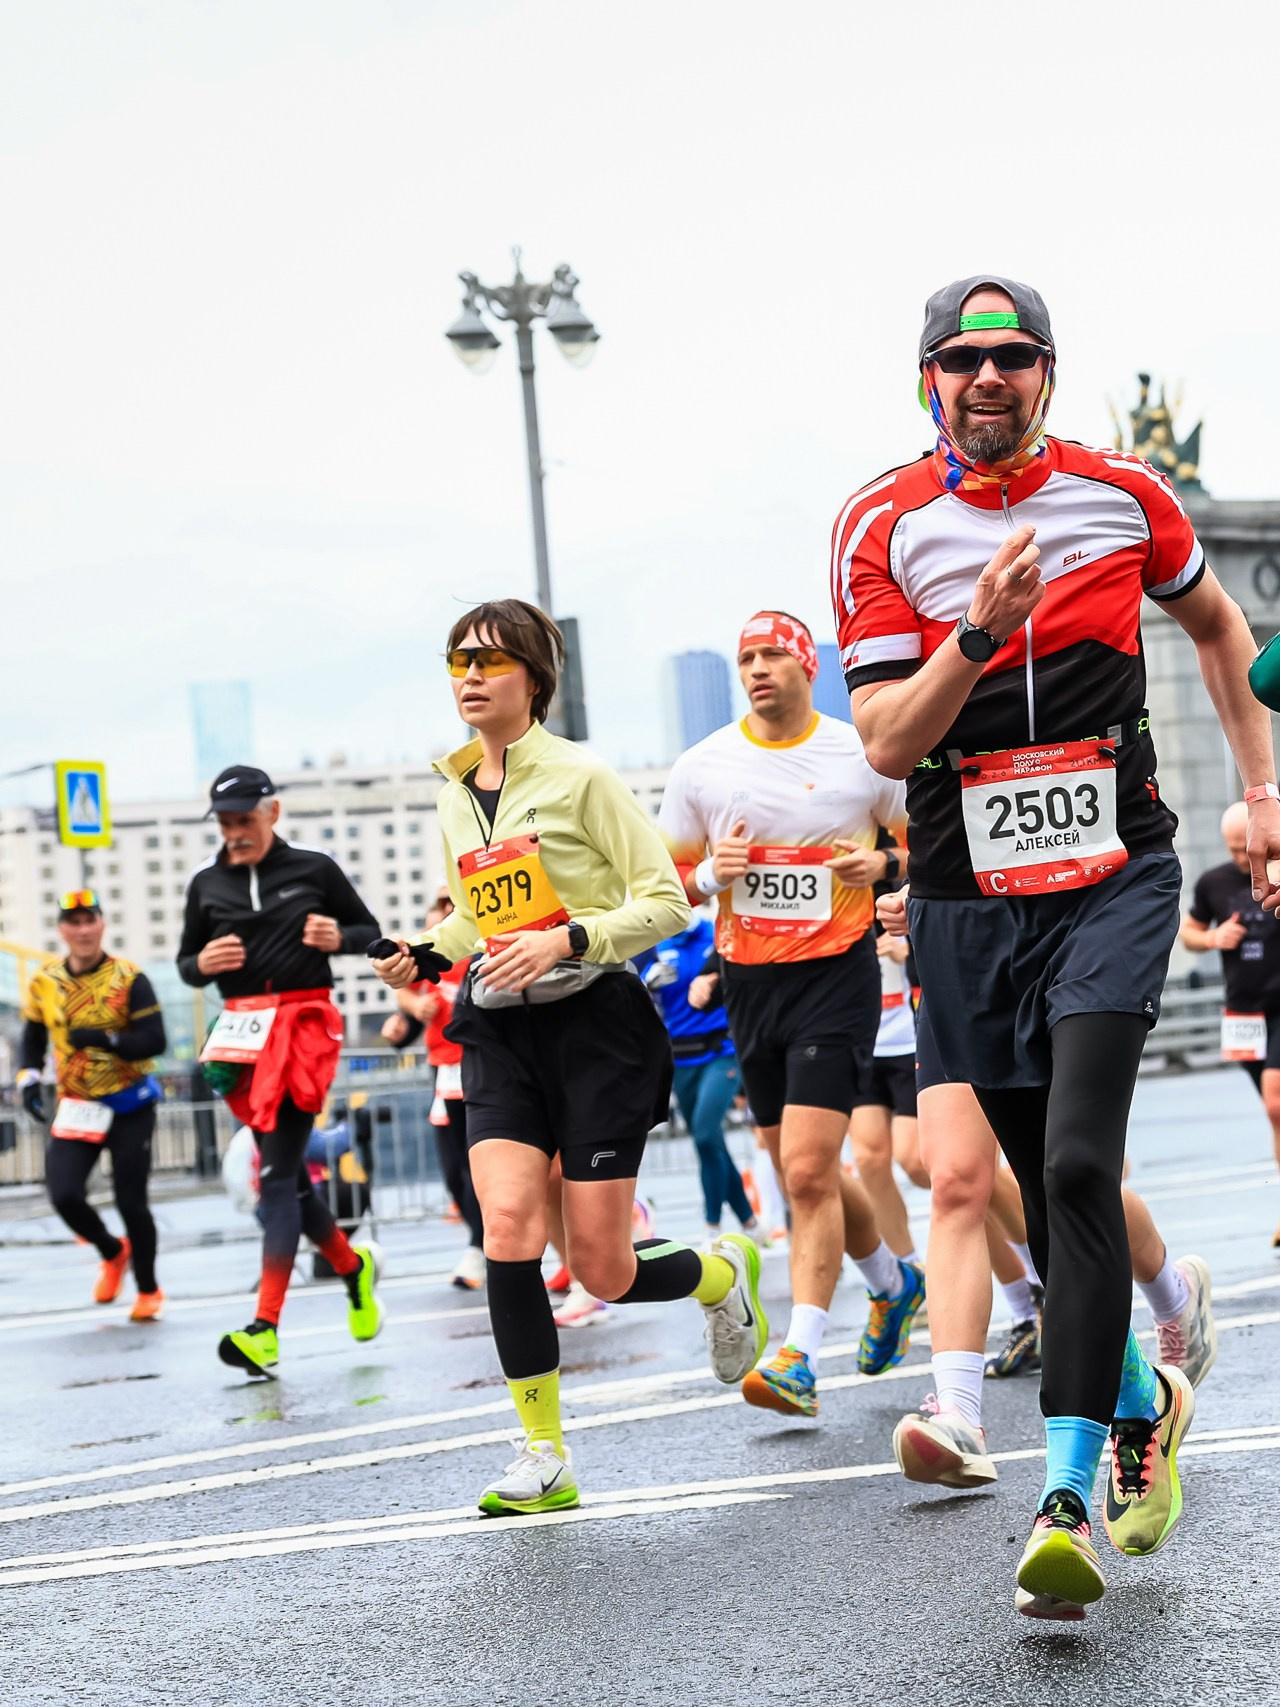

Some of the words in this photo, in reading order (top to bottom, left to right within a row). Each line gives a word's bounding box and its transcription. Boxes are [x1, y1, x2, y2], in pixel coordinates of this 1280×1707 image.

[1012, 747, 1065, 762] МОСКОВСКИЙ
[1013, 764, 1053, 775] МАРАФОН
[985, 783, 1100, 840] 2503
[1015, 829, 1080, 852] АЛЕКСЕЙ
[470, 869, 532, 919] 2379
[744, 872, 818, 900] 9503
[760, 901, 800, 910] МИХАИЛ
[496, 911, 518, 926] АННА
